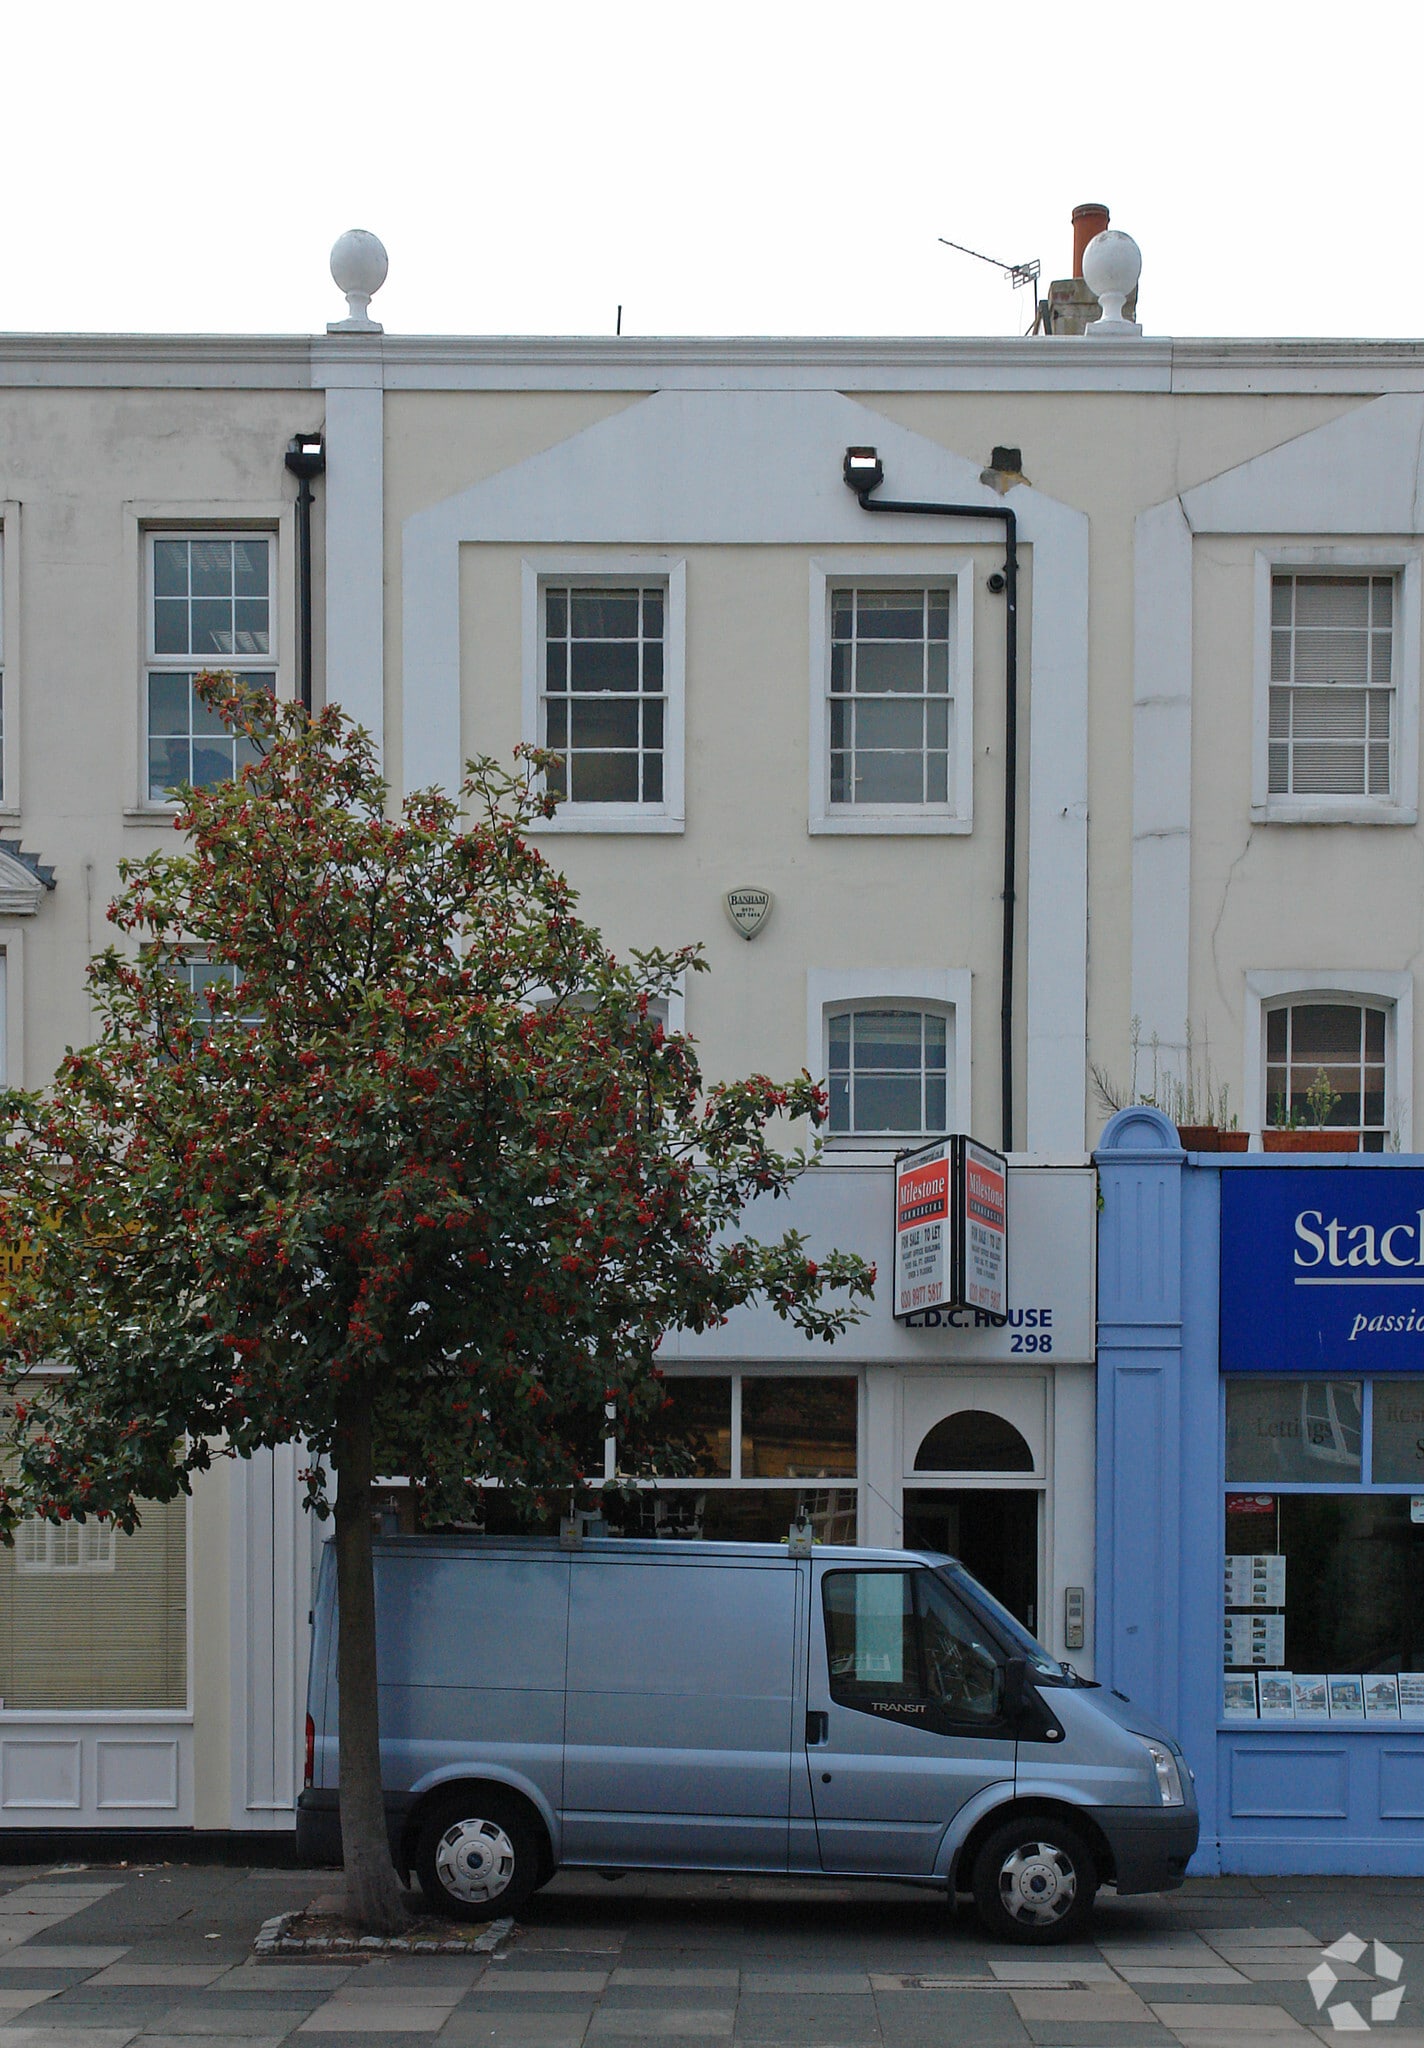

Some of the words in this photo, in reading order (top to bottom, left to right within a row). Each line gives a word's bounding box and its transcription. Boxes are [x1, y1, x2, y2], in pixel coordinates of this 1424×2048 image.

[731, 895, 766, 906] BANHAM
[899, 1176, 945, 1206] Milestone
[969, 1172, 1003, 1208] Milestone
[909, 1230, 920, 1247] SALE
[924, 1227, 931, 1242] TO
[931, 1225, 941, 1240] LET
[974, 1309, 1053, 1328] HOUSE
[1010, 1334, 1052, 1353] 298
[871, 1702, 927, 1714] TRANSIT
